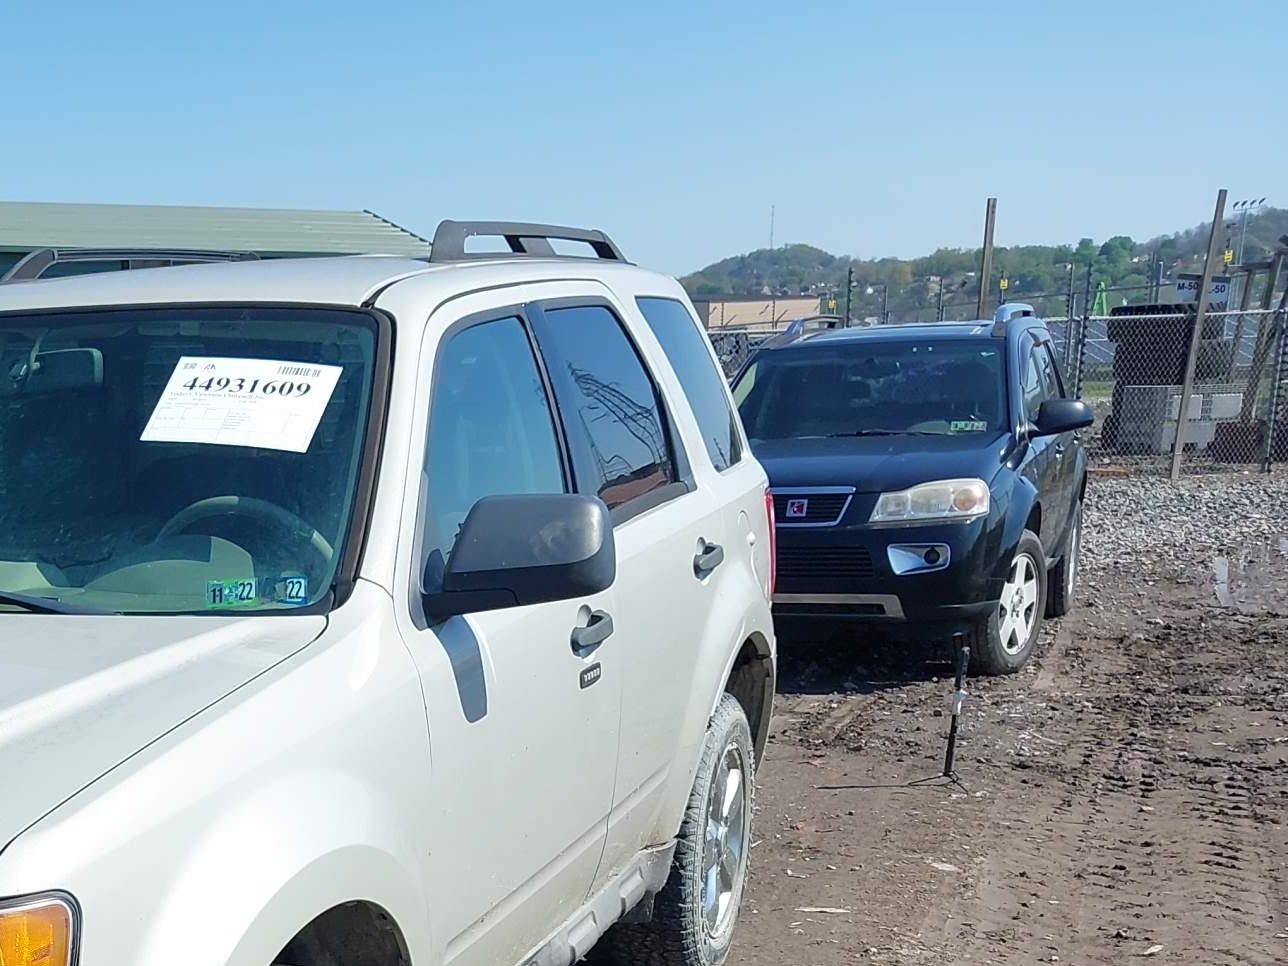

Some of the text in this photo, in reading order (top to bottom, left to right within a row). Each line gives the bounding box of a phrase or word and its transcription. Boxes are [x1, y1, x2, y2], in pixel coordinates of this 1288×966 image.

[1208, 284, 1226, 294] -50
[183, 376, 311, 398] 44931609
[211, 582, 253, 603] 11 22
[287, 580, 303, 600] 22
